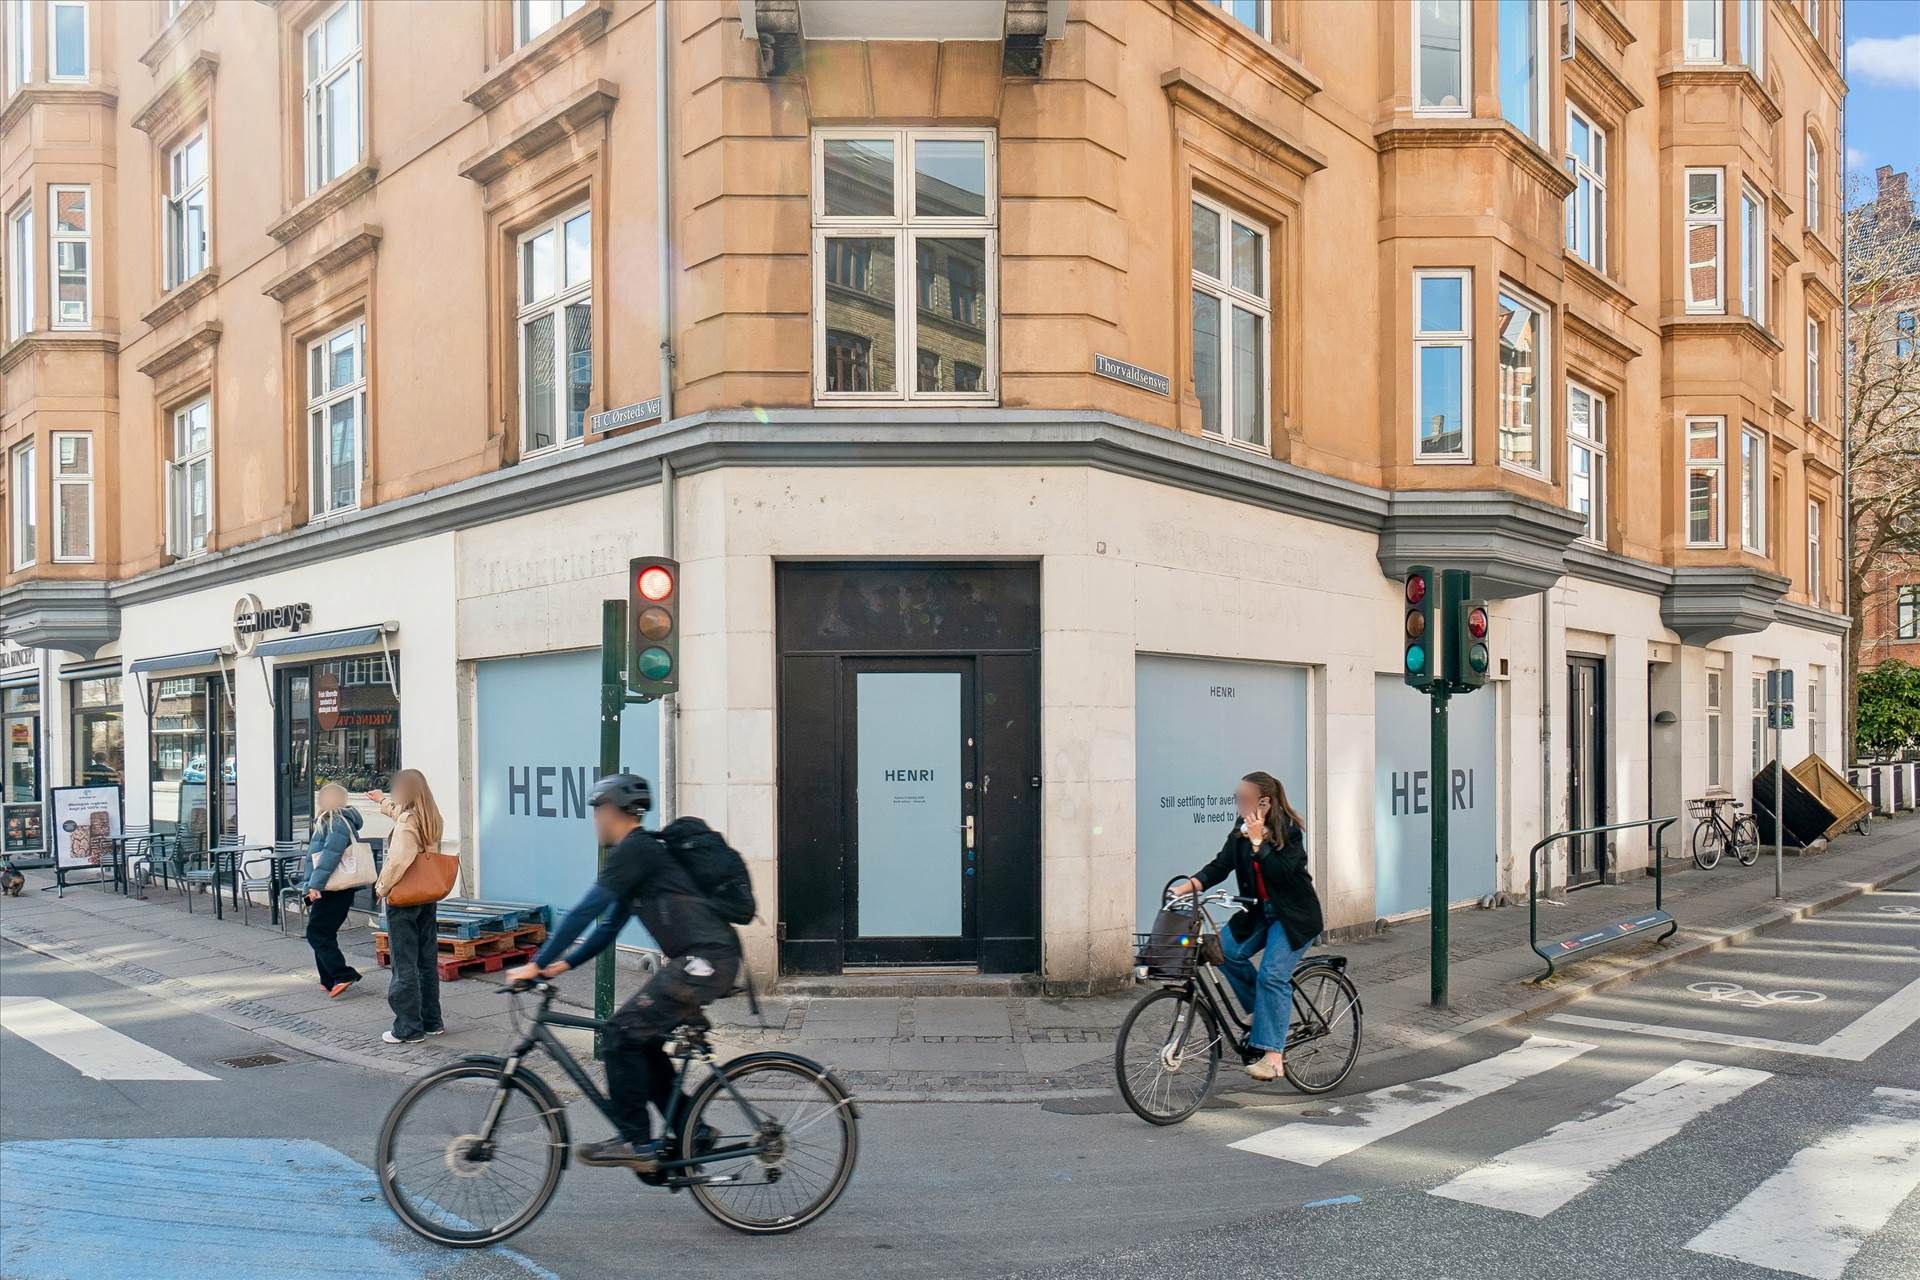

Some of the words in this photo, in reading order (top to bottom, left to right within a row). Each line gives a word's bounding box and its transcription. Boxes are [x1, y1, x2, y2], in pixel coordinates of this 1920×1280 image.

[1096, 356, 1169, 393] Thorvaldsensvej
[612, 405, 645, 422] Ørsteds
[647, 400, 661, 415] Vej
[236, 603, 304, 633] emmerys
[1210, 686, 1235, 698] HENRI
[885, 769, 934, 781] HENRI
[508, 766, 630, 819] HEN
[1160, 796, 1175, 808] Still
[1177, 795, 1205, 808] settling
[1207, 795, 1217, 806] for
[1392, 768, 1474, 816] HERI
[1193, 813, 1206, 823] We
[1207, 812, 1225, 822] need
[1227, 812, 1234, 821] to
